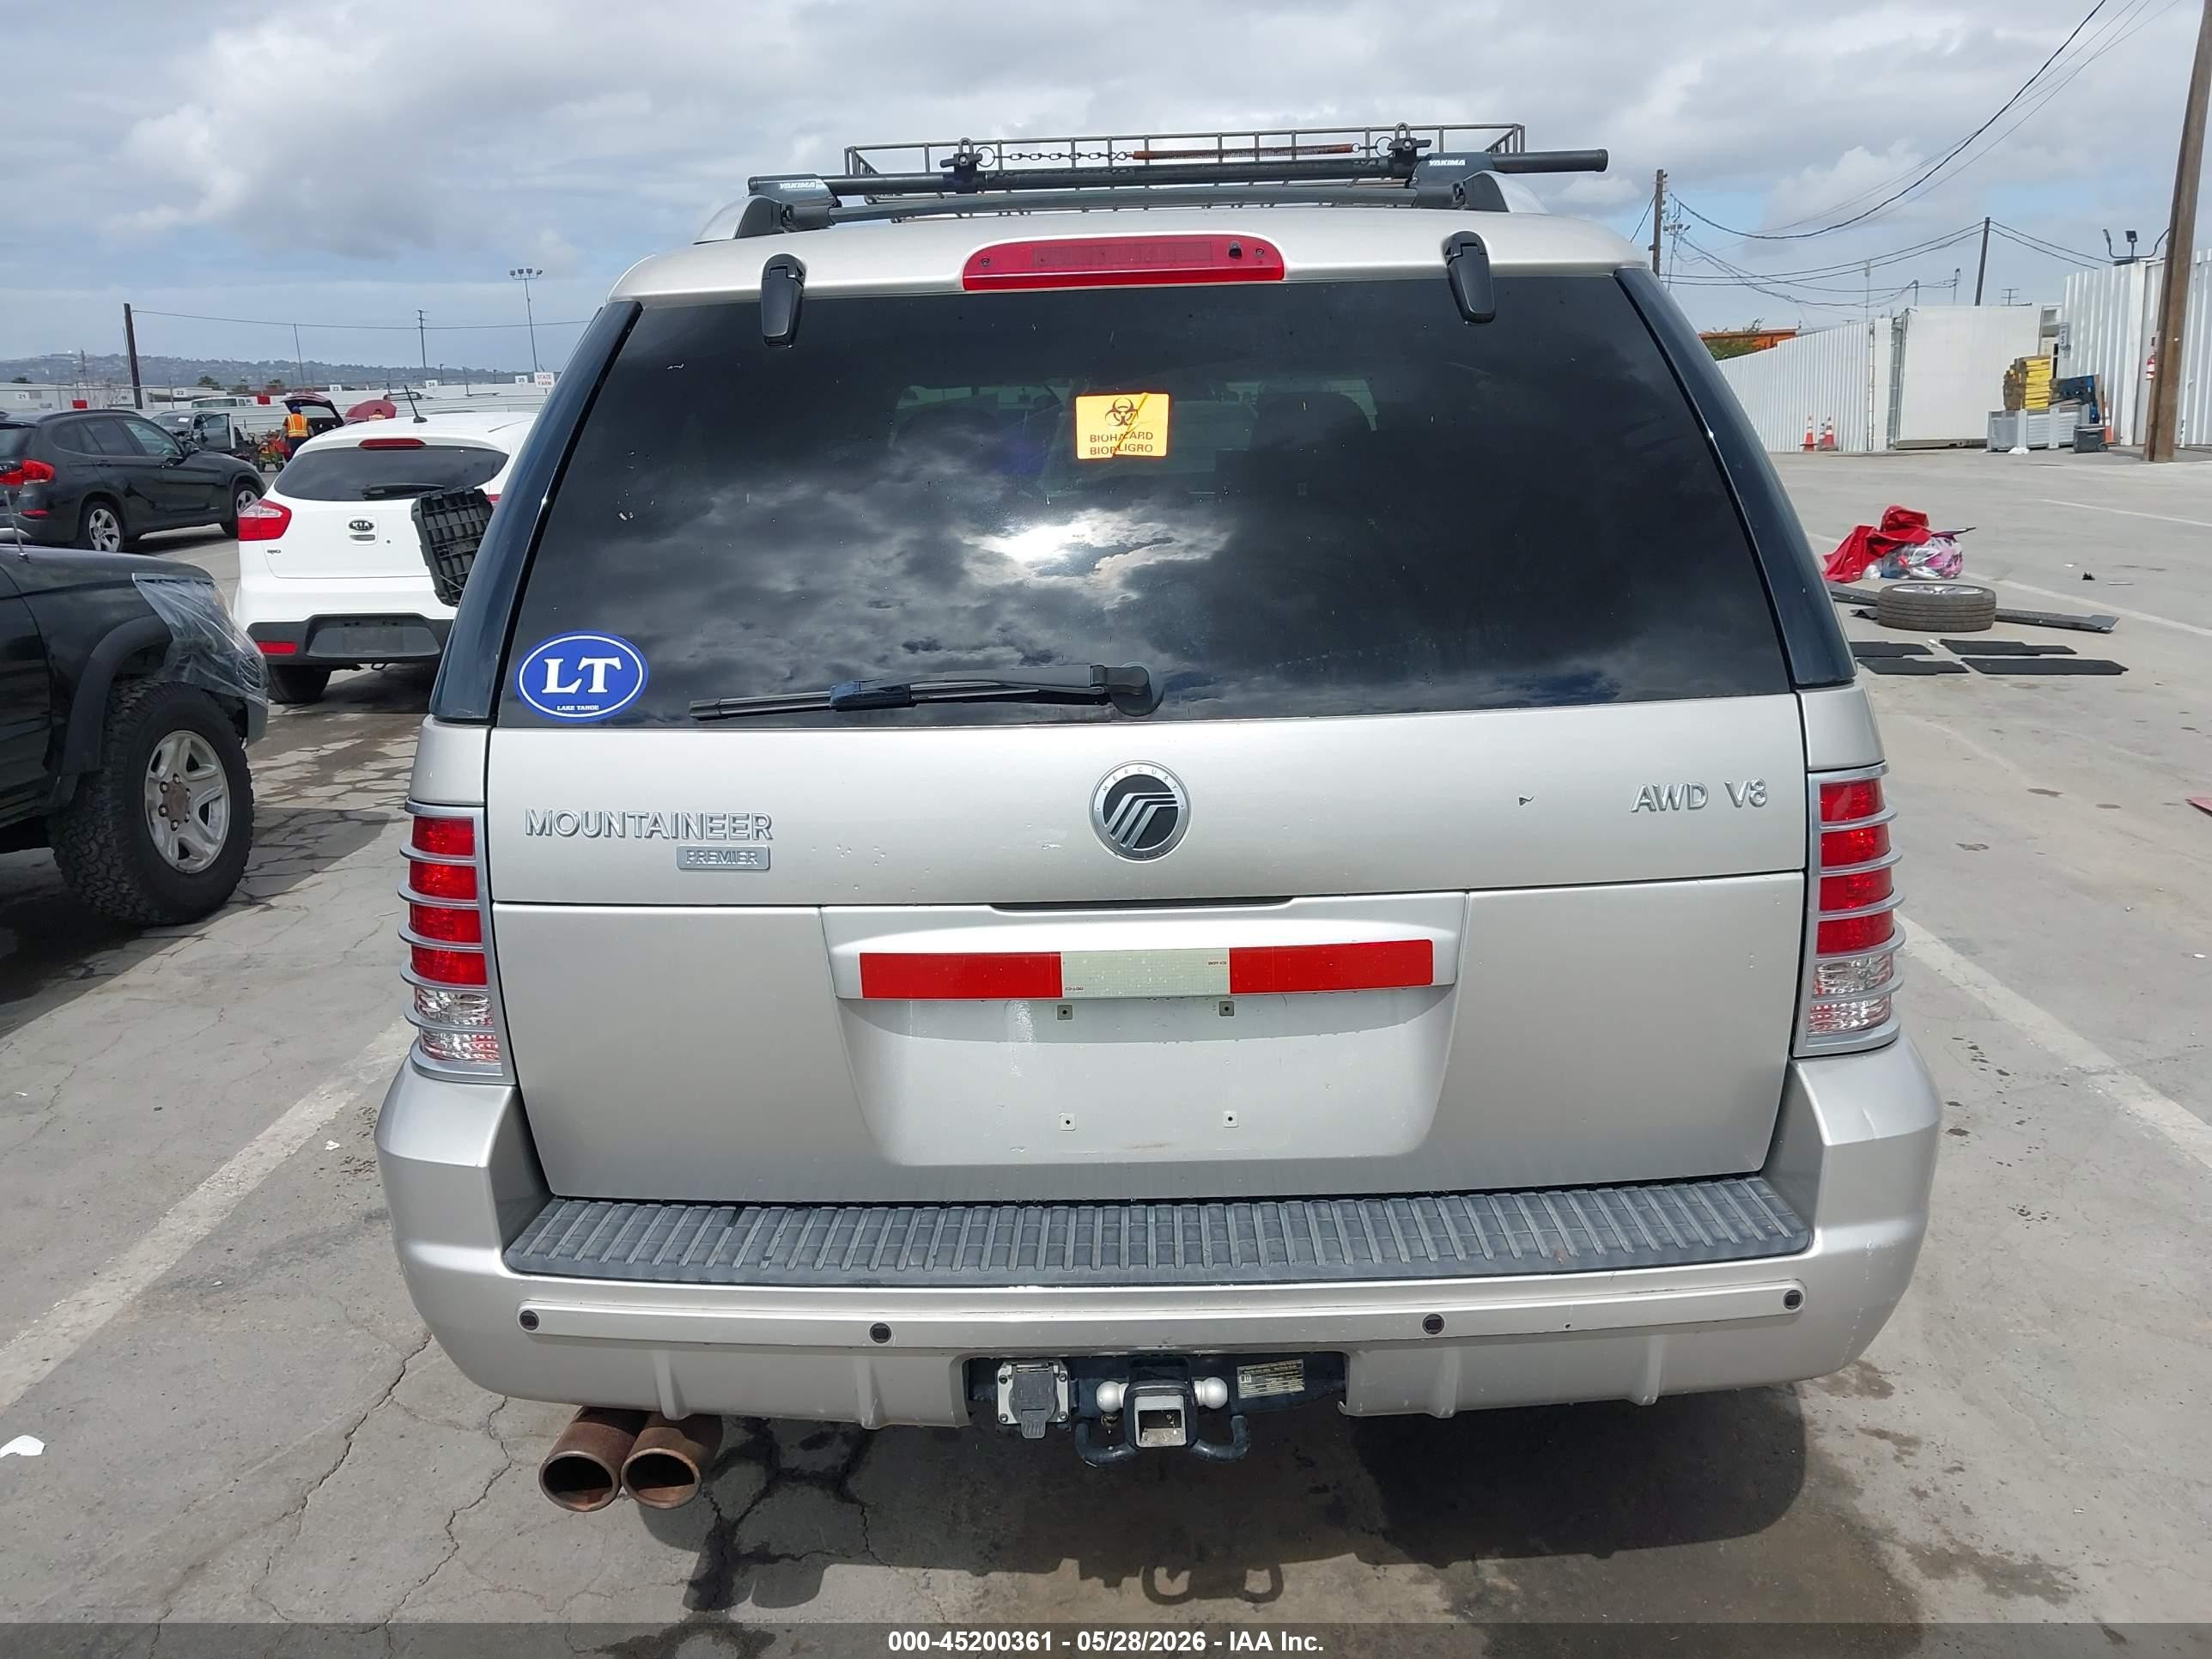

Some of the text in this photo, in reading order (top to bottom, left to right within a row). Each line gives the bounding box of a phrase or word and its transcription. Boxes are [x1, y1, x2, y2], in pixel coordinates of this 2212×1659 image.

[351, 521, 370, 530] KIA
[541, 656, 623, 695] LT
[1102, 766, 1179, 793] MERCURY
[1630, 777, 1767, 813] AWD V8
[525, 808, 774, 841] MOUNTAINEER
[686, 850, 759, 866] PREMIER
